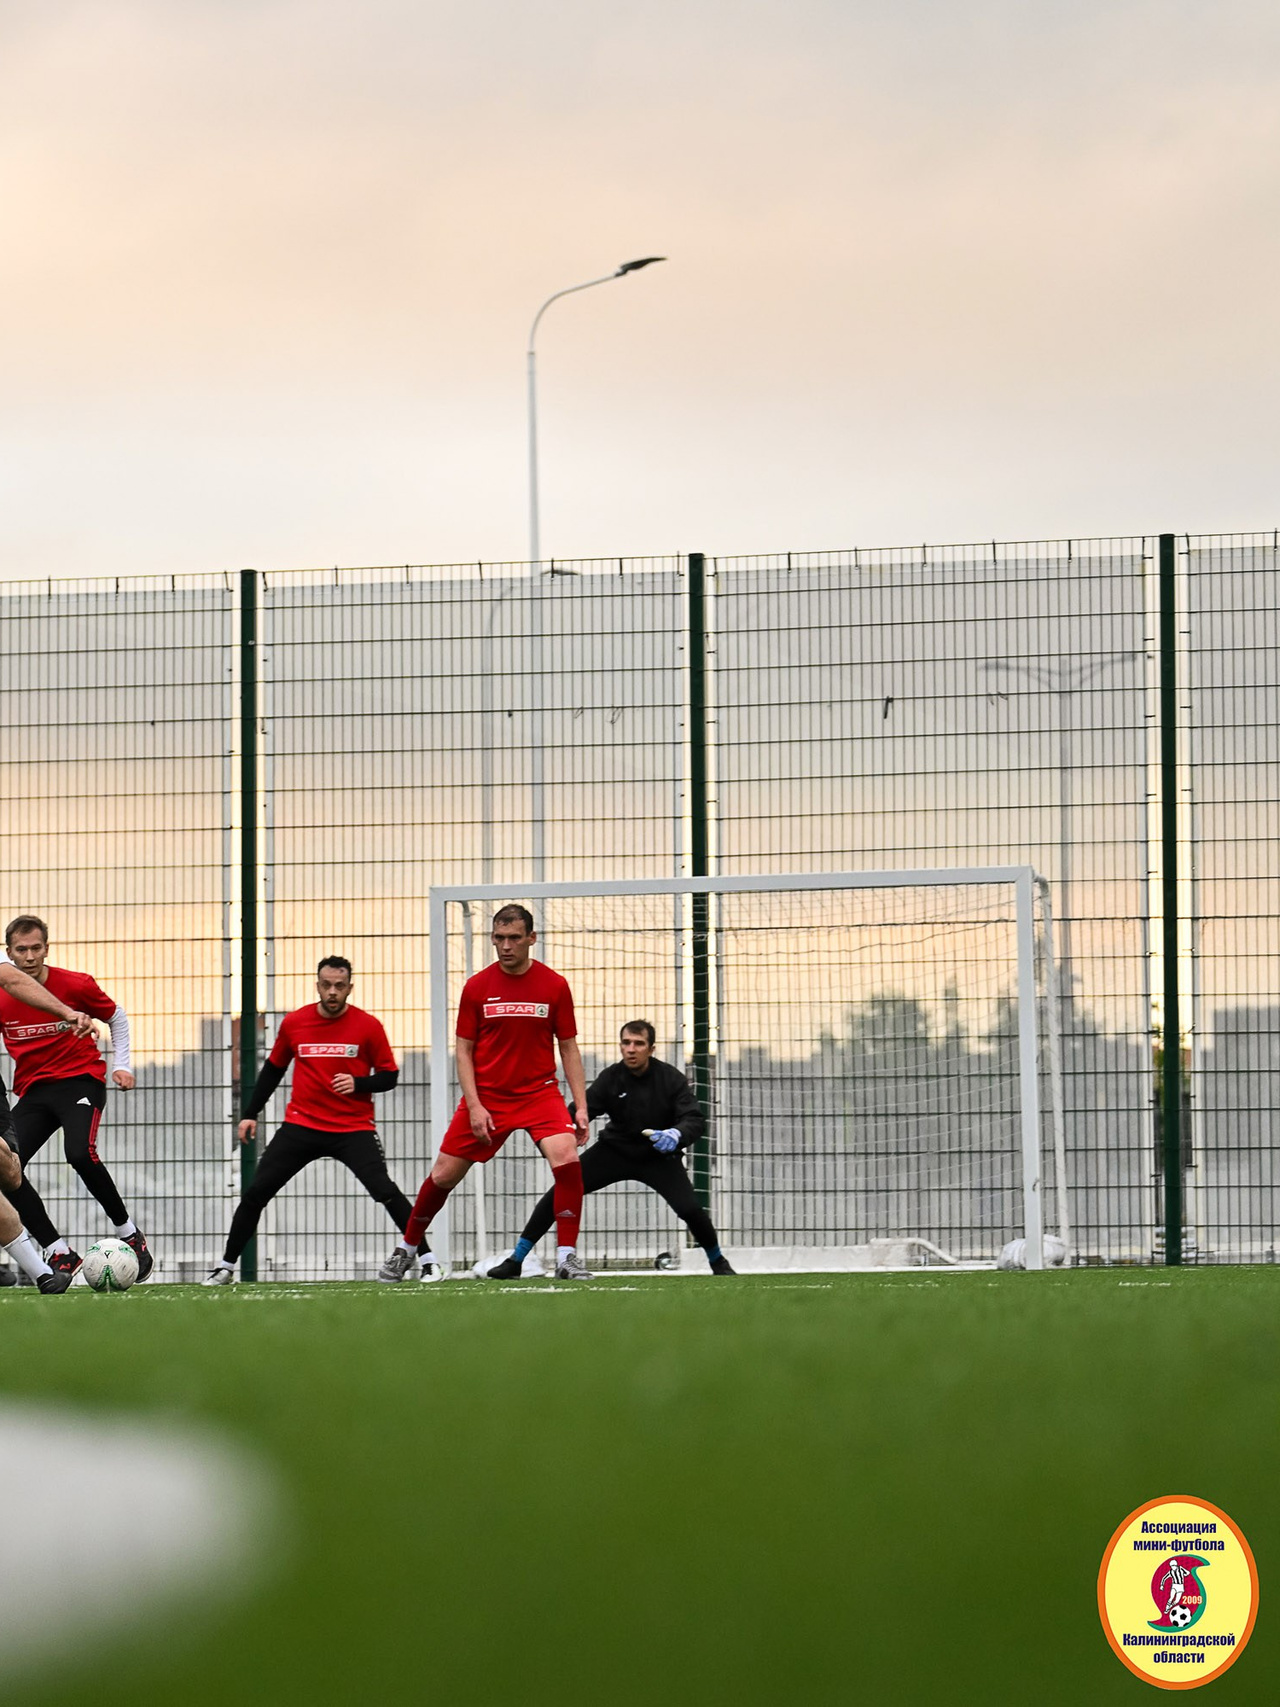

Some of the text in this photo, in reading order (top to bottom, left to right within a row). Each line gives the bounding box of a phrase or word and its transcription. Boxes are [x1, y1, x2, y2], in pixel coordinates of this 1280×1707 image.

[495, 1005, 534, 1014] SPAR
[17, 1026, 56, 1037] SPAR
[309, 1046, 344, 1054] SPAR
